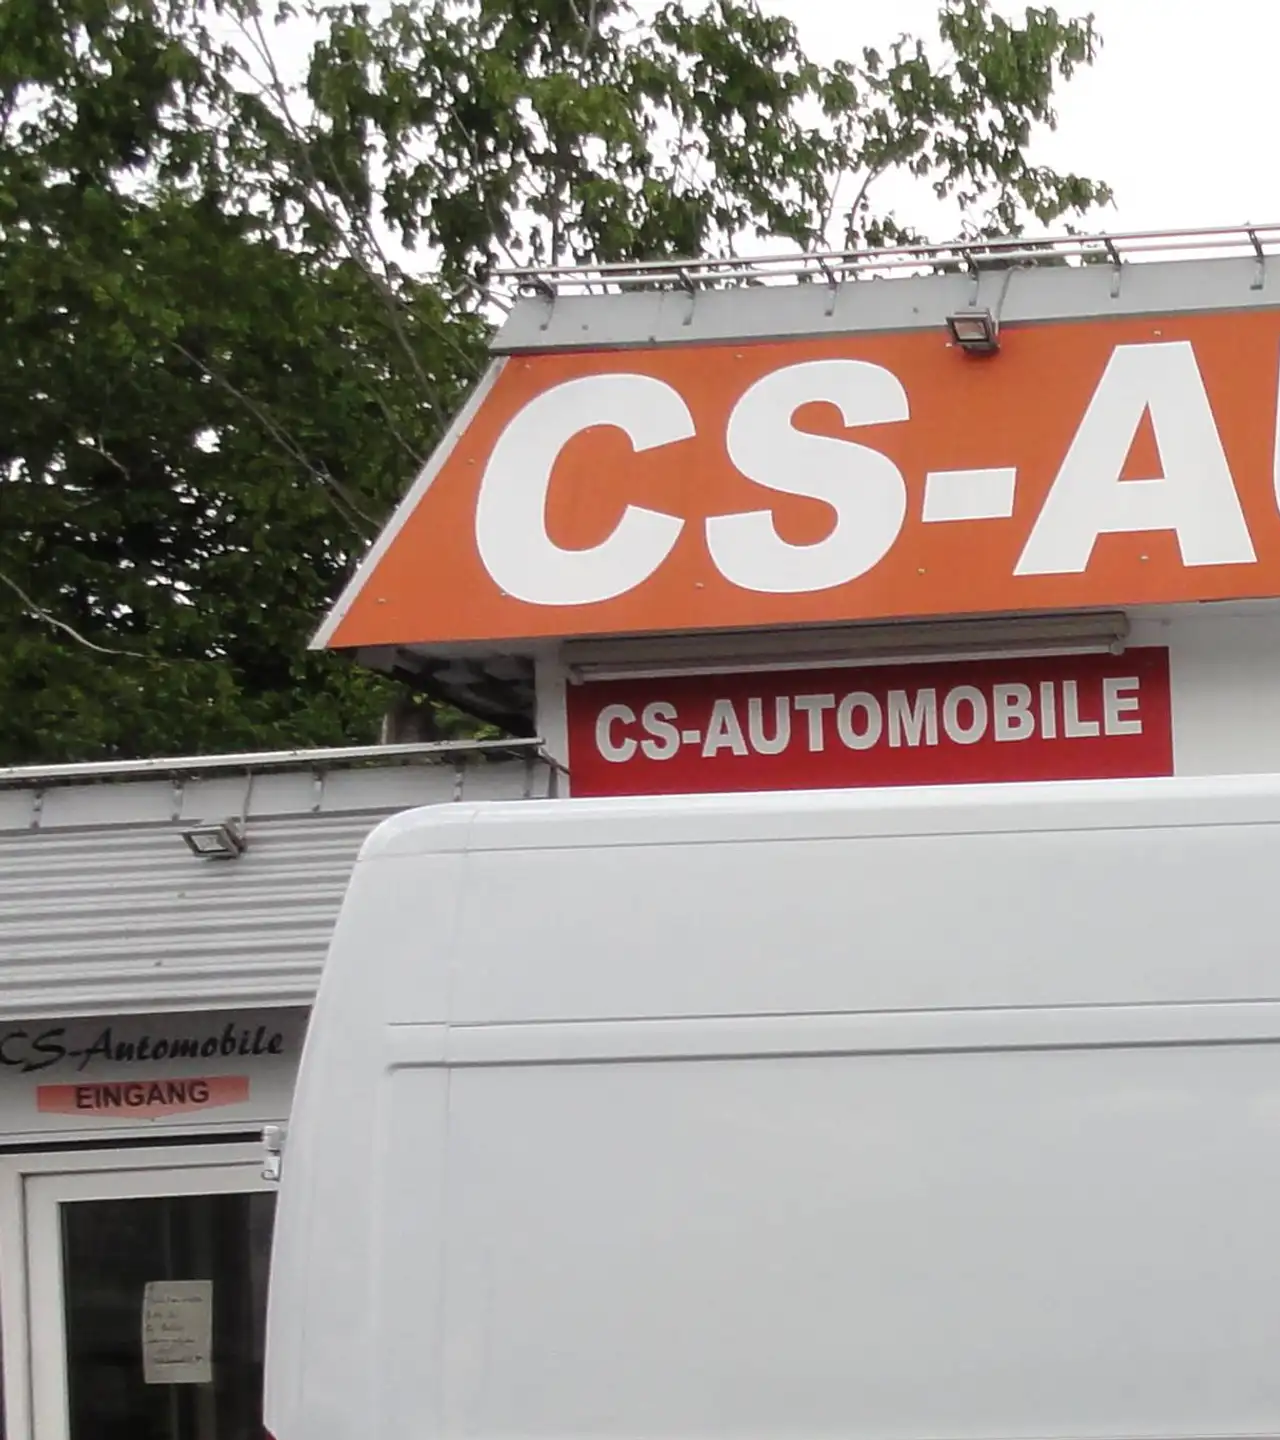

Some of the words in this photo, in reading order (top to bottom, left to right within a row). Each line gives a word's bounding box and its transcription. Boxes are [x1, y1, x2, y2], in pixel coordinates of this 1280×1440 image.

[595, 676, 1142, 762] CS-AUTOMOBILE
[0, 1023, 284, 1073] CS-Automobile
[75, 1081, 209, 1109] EINGANG
